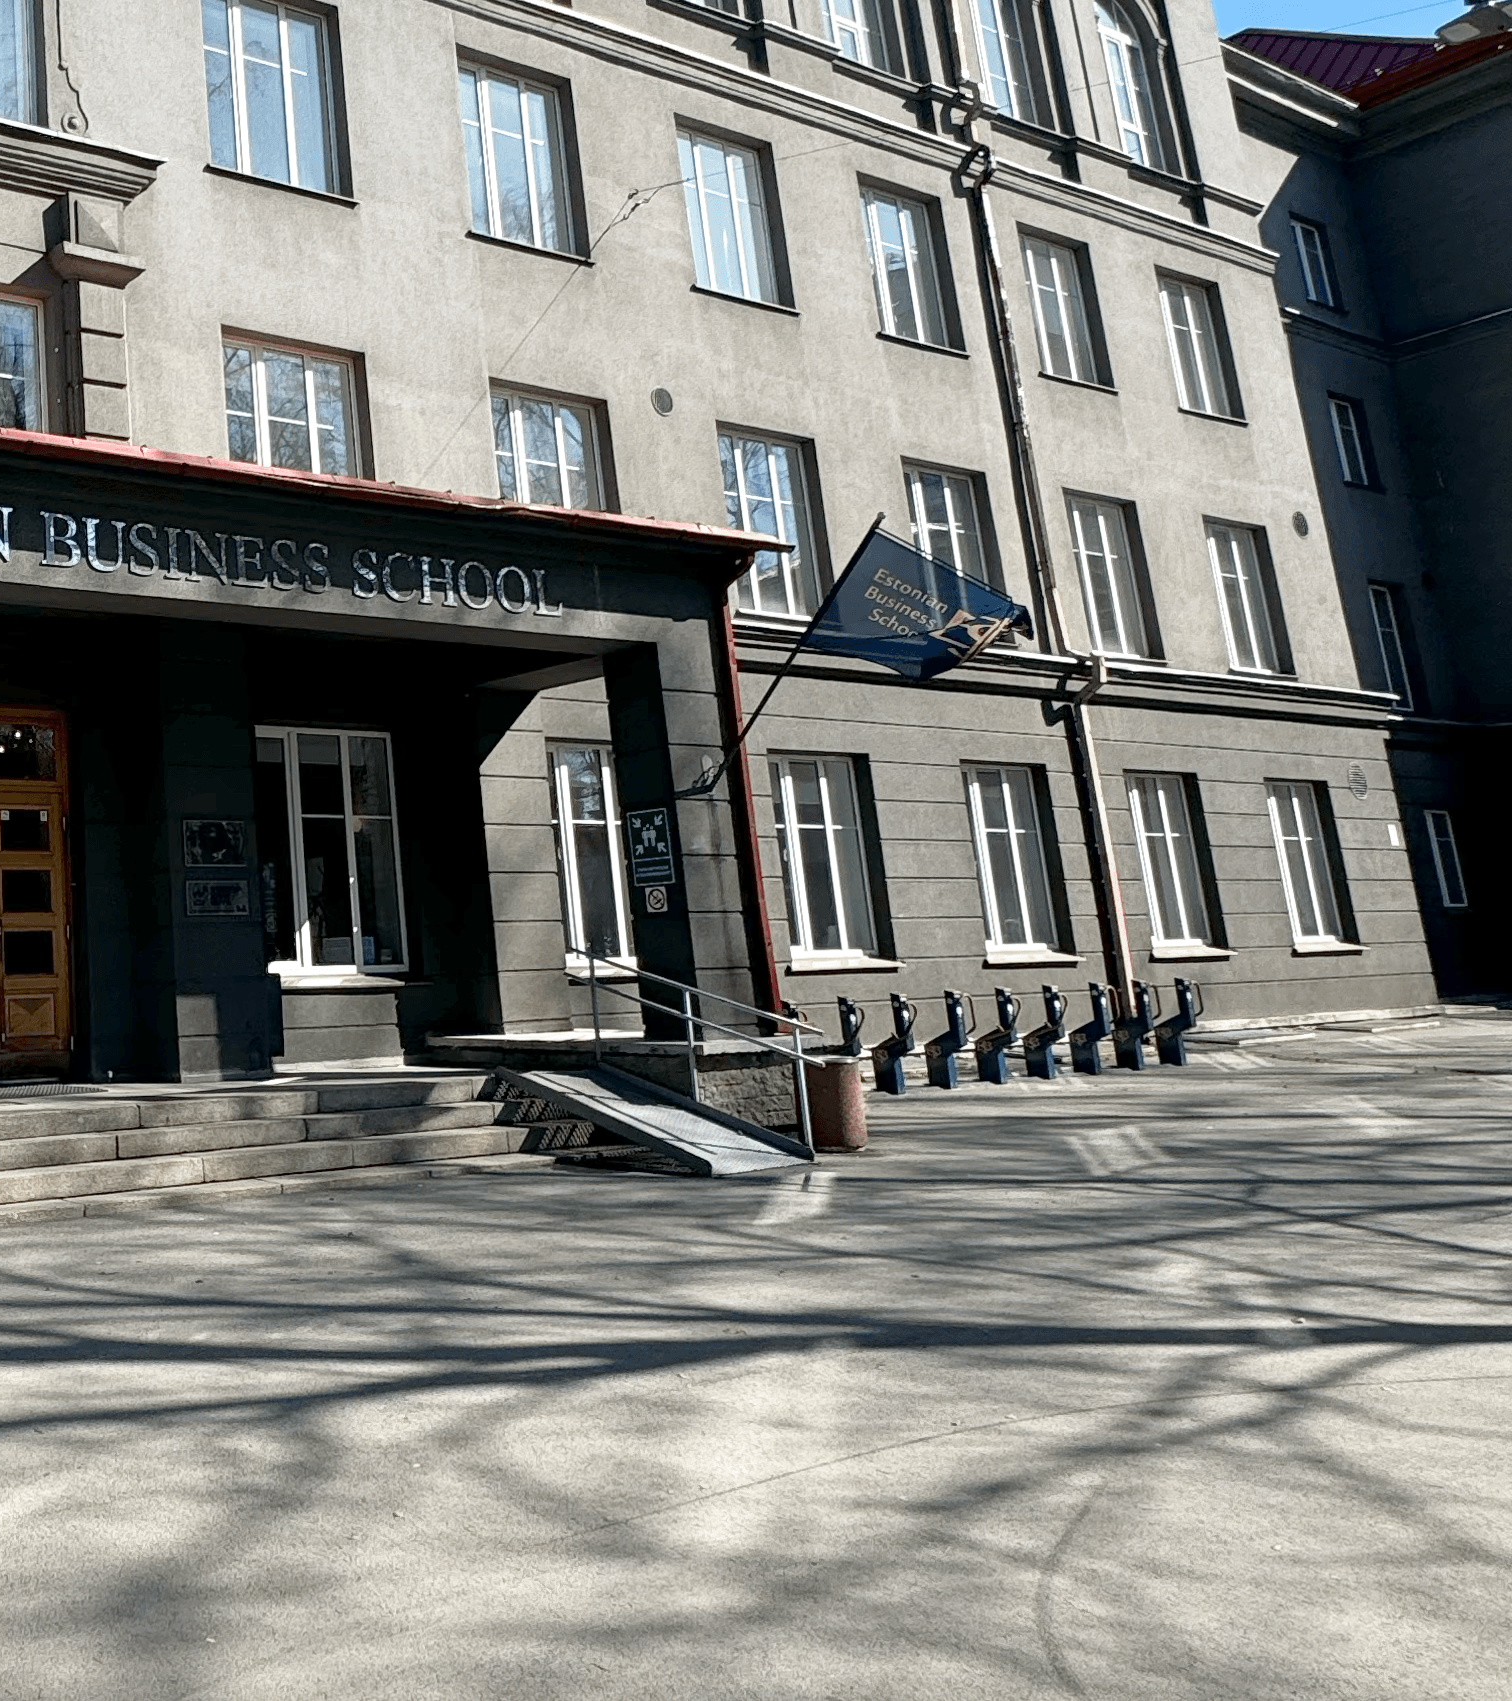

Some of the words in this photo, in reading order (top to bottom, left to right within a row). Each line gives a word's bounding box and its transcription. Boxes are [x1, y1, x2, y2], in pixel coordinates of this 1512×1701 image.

[39, 509, 332, 594] BUSINESS
[351, 548, 563, 618] SCHOOL
[864, 585, 937, 631] Business
[873, 568, 948, 614] Estonian
[868, 608, 918, 637] Scho
